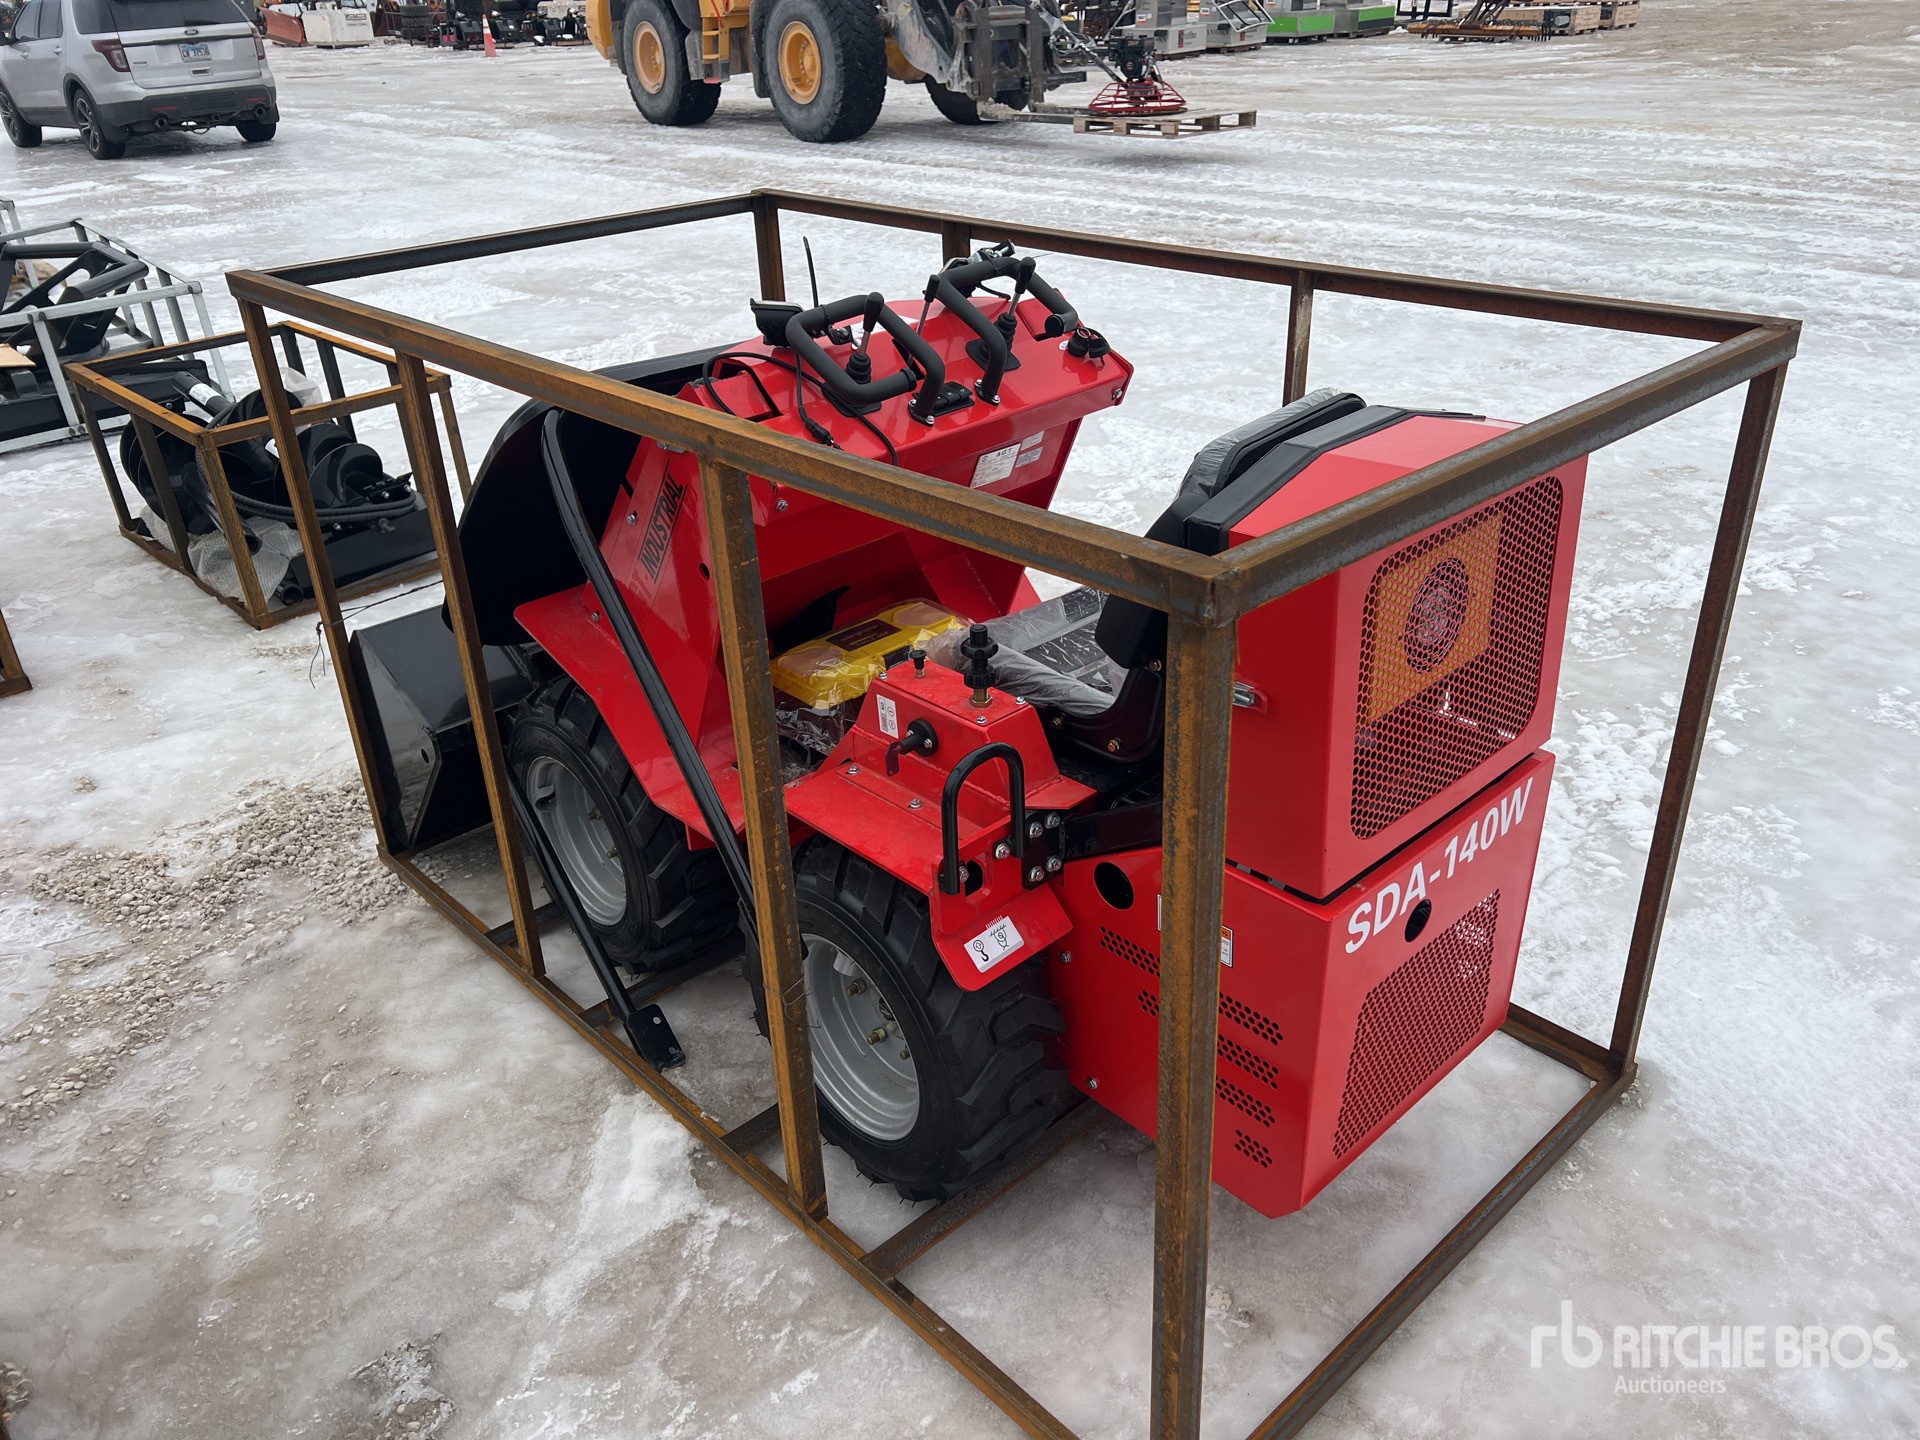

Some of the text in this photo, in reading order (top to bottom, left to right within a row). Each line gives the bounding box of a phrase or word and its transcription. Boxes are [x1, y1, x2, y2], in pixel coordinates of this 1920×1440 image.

[996, 448, 1013, 457] AGT
[640, 472, 684, 580] INDUSTRIAL
[1345, 777, 1533, 954] SDA-140W
